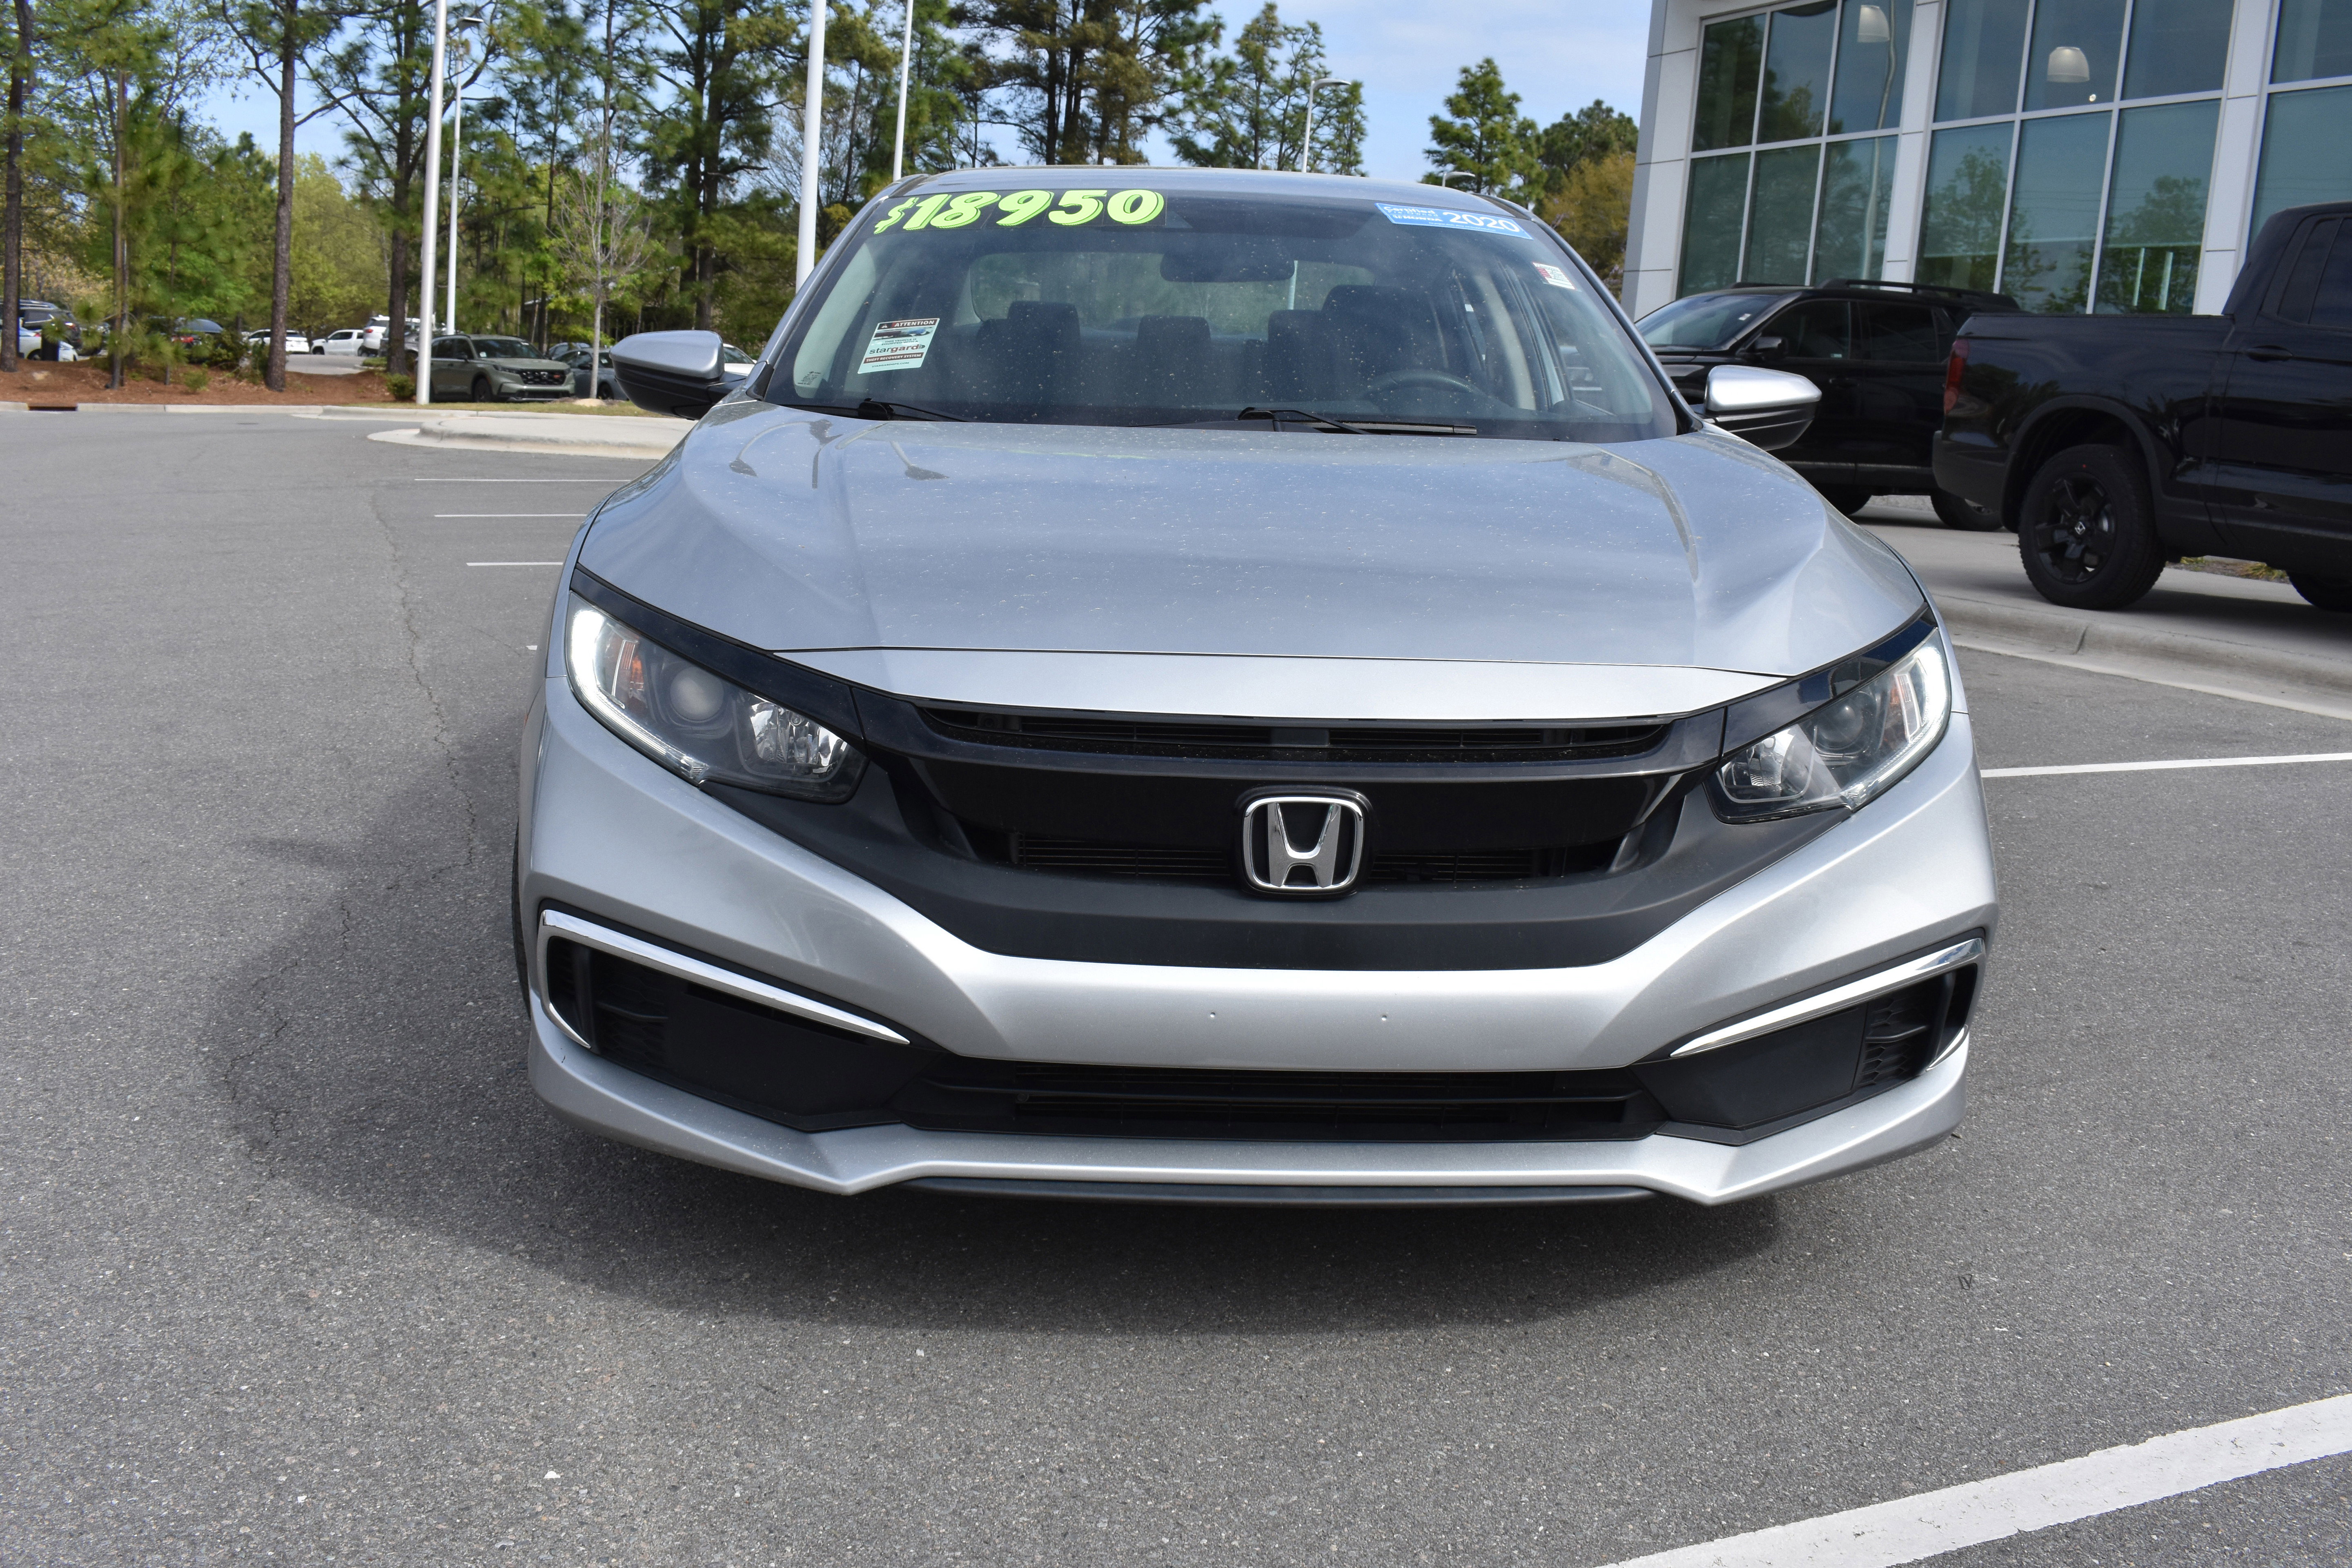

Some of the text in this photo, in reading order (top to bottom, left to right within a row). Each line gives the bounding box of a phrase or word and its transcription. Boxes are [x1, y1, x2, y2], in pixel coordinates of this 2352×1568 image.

[873, 189, 1164, 234] $18950
[1383, 206, 1436, 214] Certified
[1442, 212, 1520, 232] 2020
